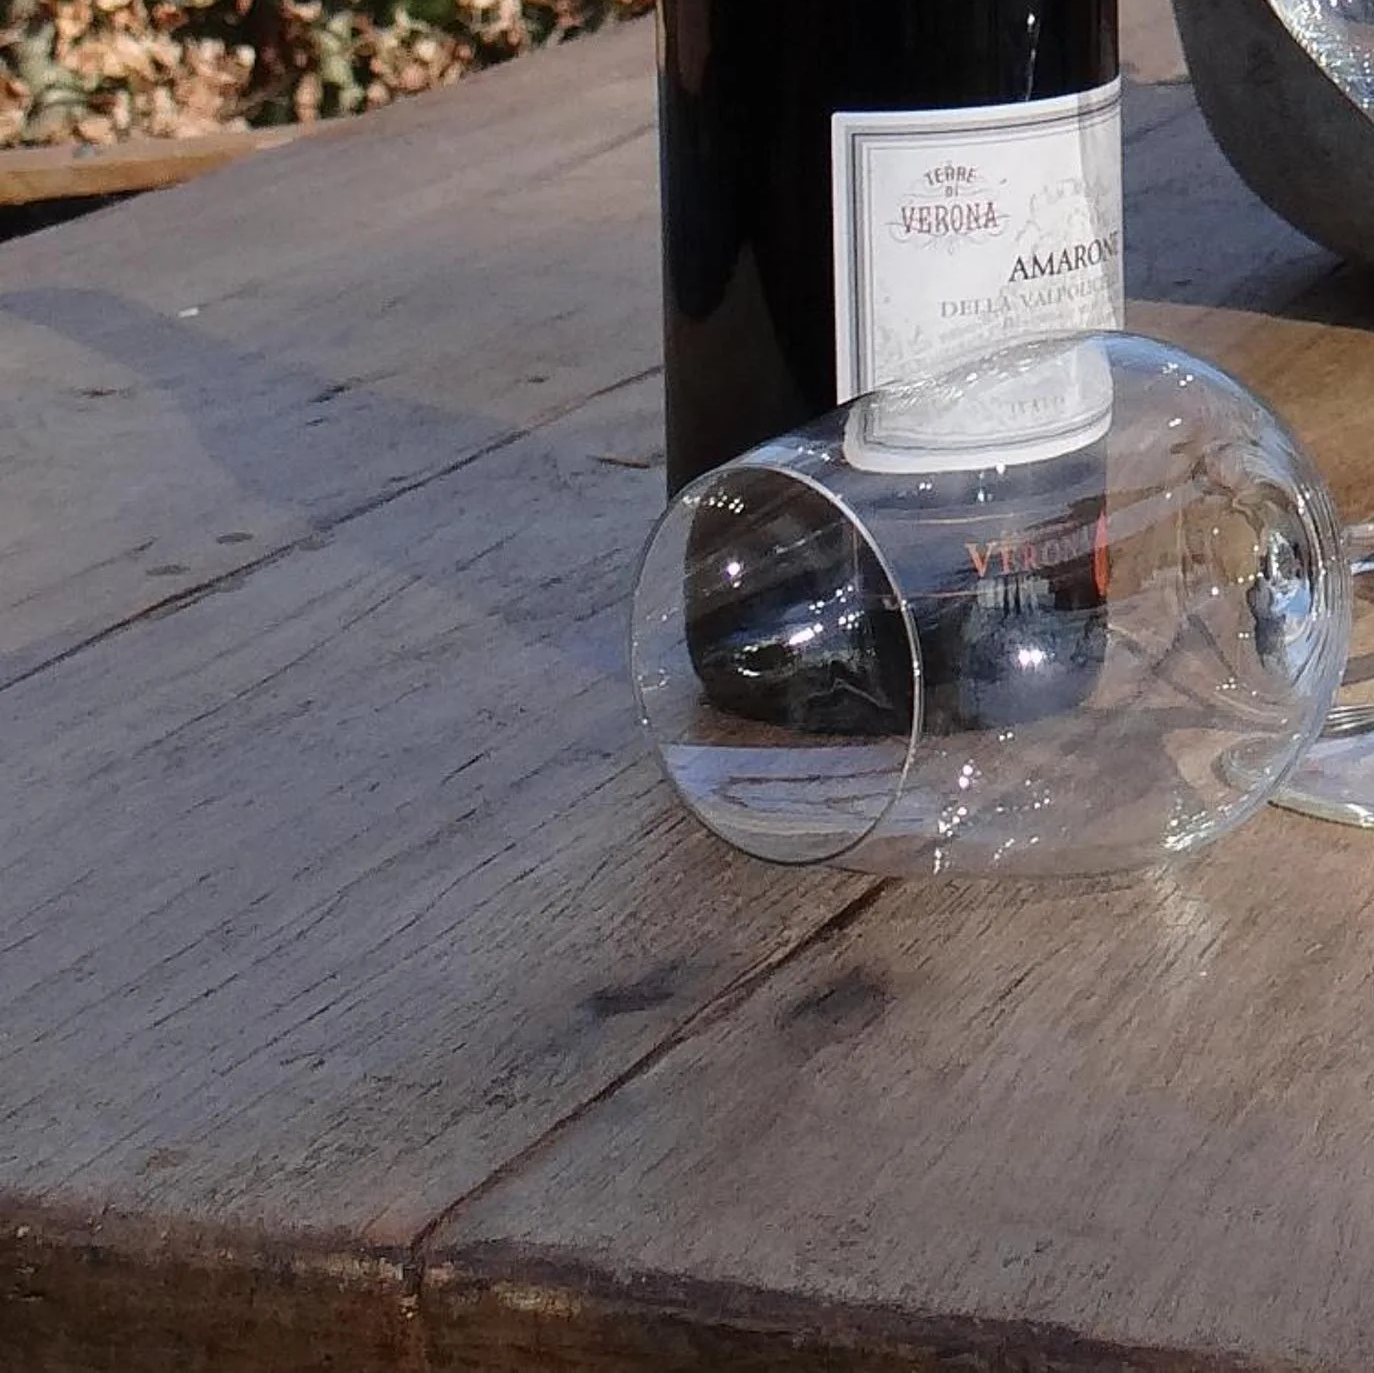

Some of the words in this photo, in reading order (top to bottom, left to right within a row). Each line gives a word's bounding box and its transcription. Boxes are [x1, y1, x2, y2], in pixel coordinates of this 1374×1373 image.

[924, 165, 977, 186] TERRE
[945, 185, 959, 198] DI
[901, 202, 999, 233] VERONA
[940, 295, 1013, 318] DELLA
